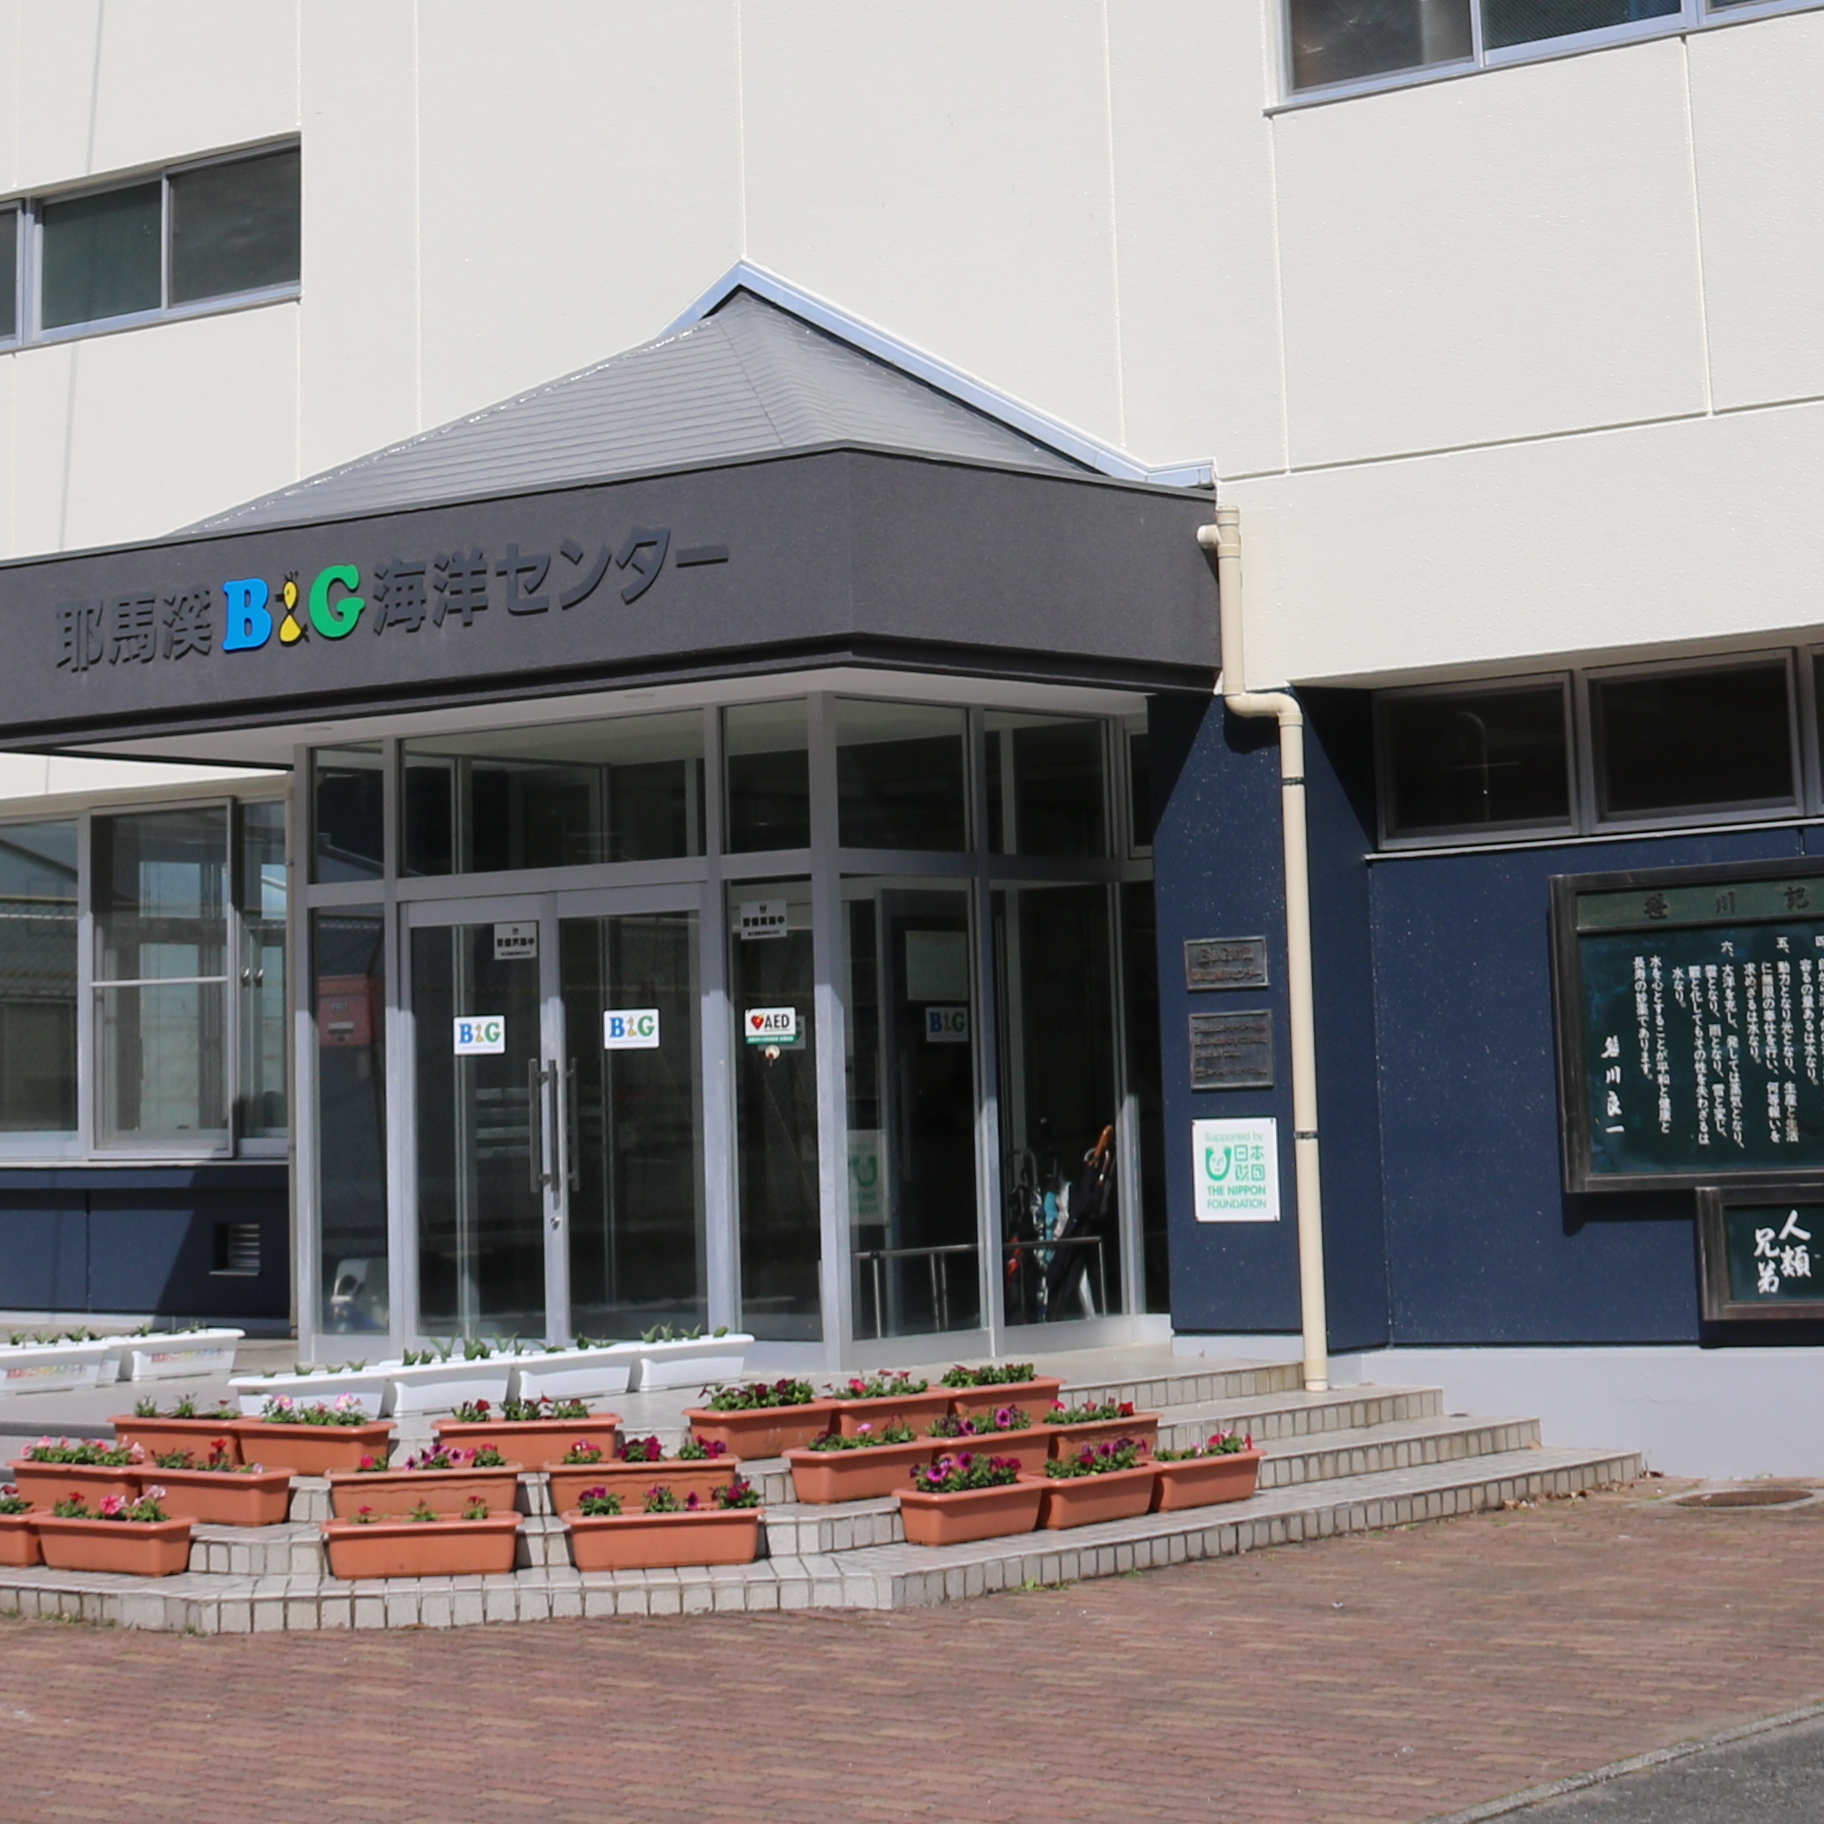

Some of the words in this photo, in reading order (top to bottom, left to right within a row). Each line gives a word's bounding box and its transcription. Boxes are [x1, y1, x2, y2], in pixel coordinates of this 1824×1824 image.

[1672, 967, 1686, 1007] 水なり。
[764, 1014, 790, 1029] AED
[1205, 1132, 1250, 1143] Supported
[1253, 1132, 1263, 1143] by
[1207, 1186, 1225, 1195] THE
[1227, 1185, 1266, 1195] NIPPON
[1207, 1199, 1266, 1208] FOUNDATION
[1778, 1209, 1811, 1277] 人類
[1754, 1227, 1780, 1294] 兄弟
